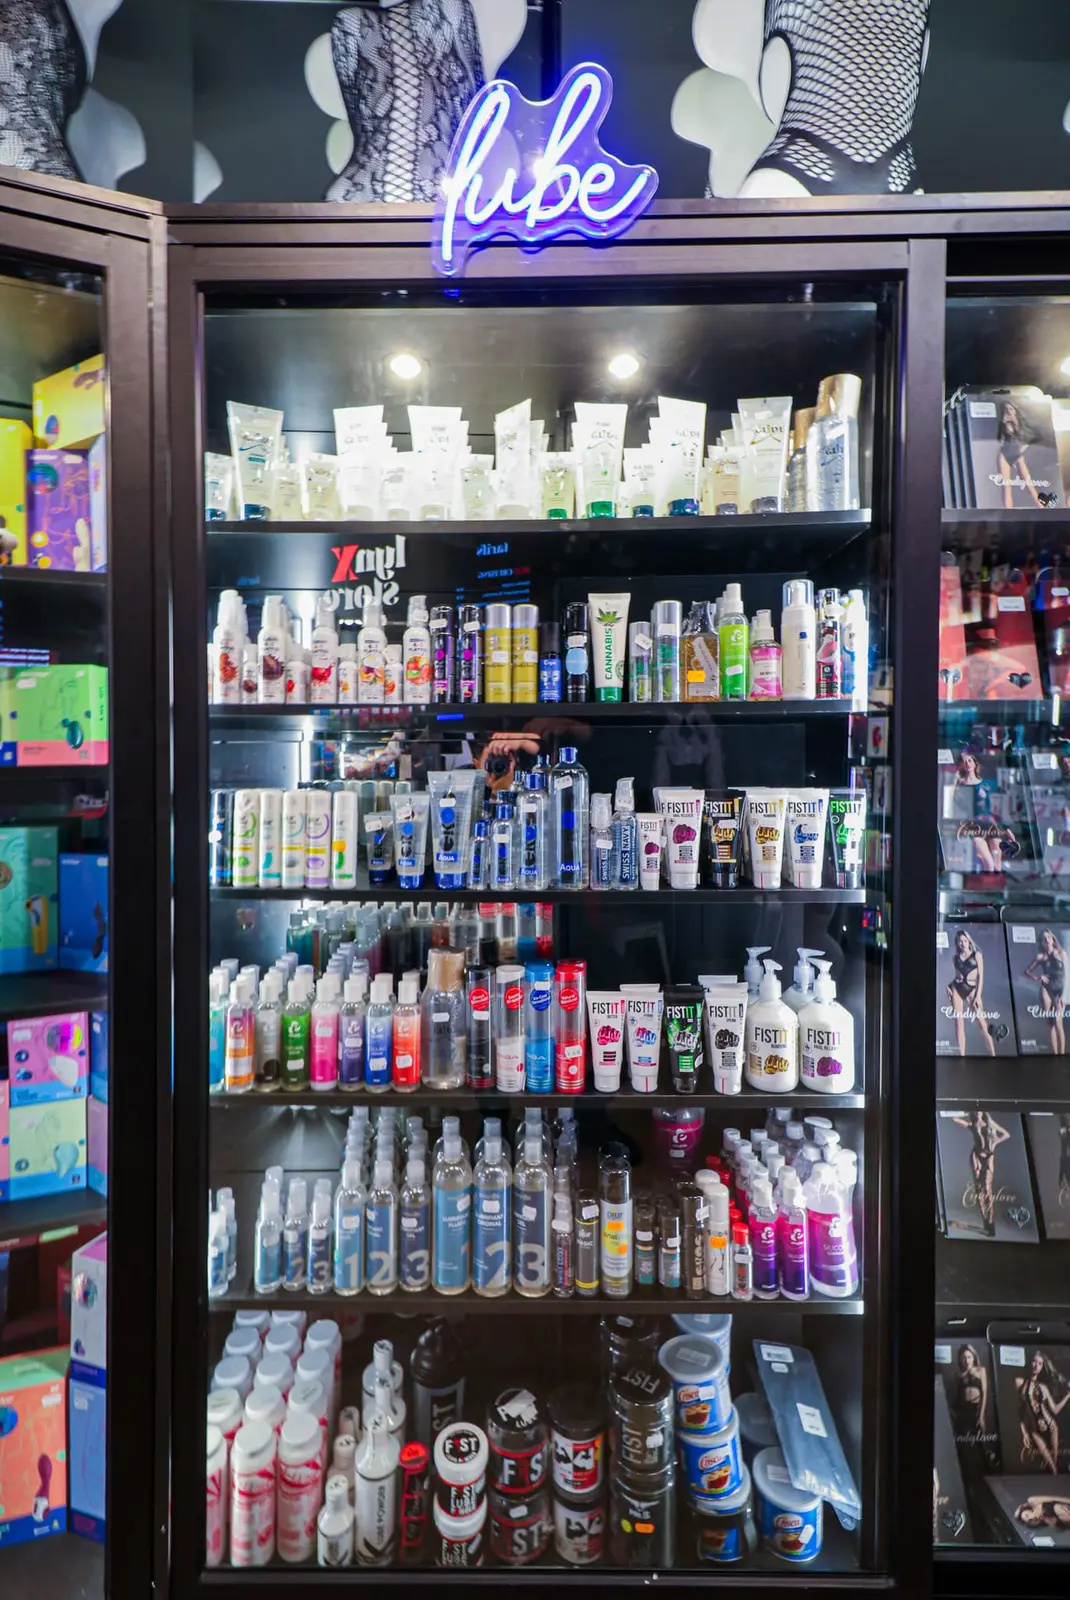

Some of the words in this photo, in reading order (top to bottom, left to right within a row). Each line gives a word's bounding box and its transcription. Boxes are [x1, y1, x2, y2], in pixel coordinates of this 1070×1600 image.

[442, 73, 650, 260] lube
[605, 627, 613, 680] CANNABIS
[667, 802, 695, 814] FISTIT
[705, 802, 733, 813] FISTIT
[750, 803, 777, 814] FISTIT
[788, 802, 817, 813] FISTIT
[622, 826, 630, 850] NAVY
[622, 853, 630, 879] SWISS
[592, 1003, 619, 1014] FISTIT
[628, 1001, 655, 1013] FISTIT
[667, 1006, 694, 1019] FISTIT
[710, 1006, 737, 1018] FISTIT
[755, 1027, 788, 1044] FISTIT
[313, 1261, 329, 1284] 3
[345, 1252, 358, 1285] 1
[407, 1250, 429, 1285] 3
[518, 1243, 545, 1287] 3
